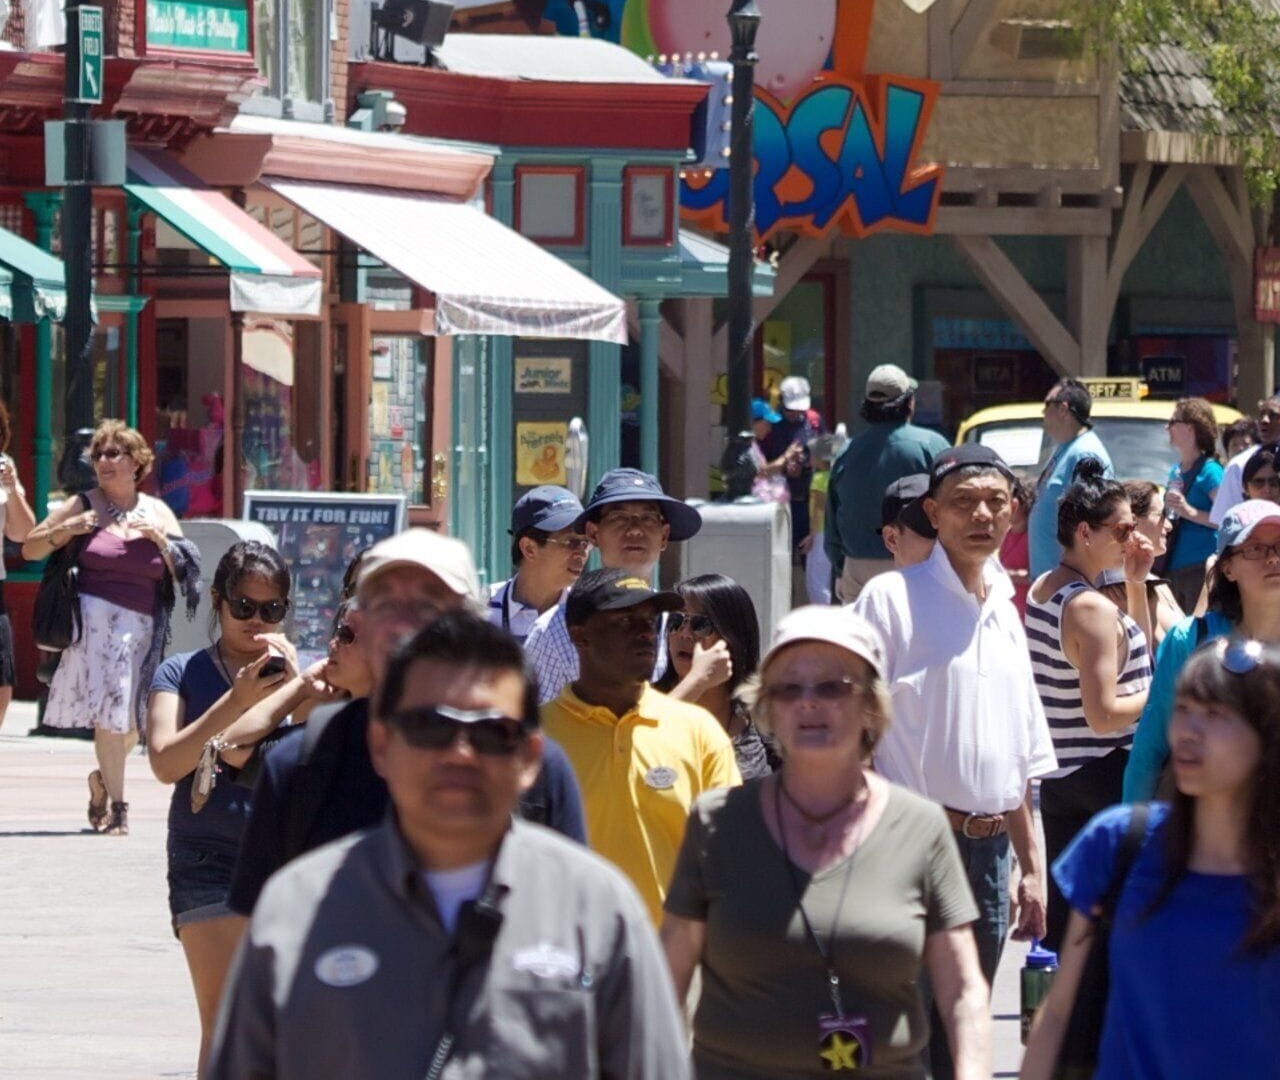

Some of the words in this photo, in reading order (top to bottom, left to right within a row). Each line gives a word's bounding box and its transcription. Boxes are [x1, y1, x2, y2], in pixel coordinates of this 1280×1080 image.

[1148, 367, 1182, 382] ATM
[256, 506, 289, 522] TRY
[291, 507, 310, 522] IT
[312, 508, 347, 523] FOR
[349, 510, 390, 525] FUN!
